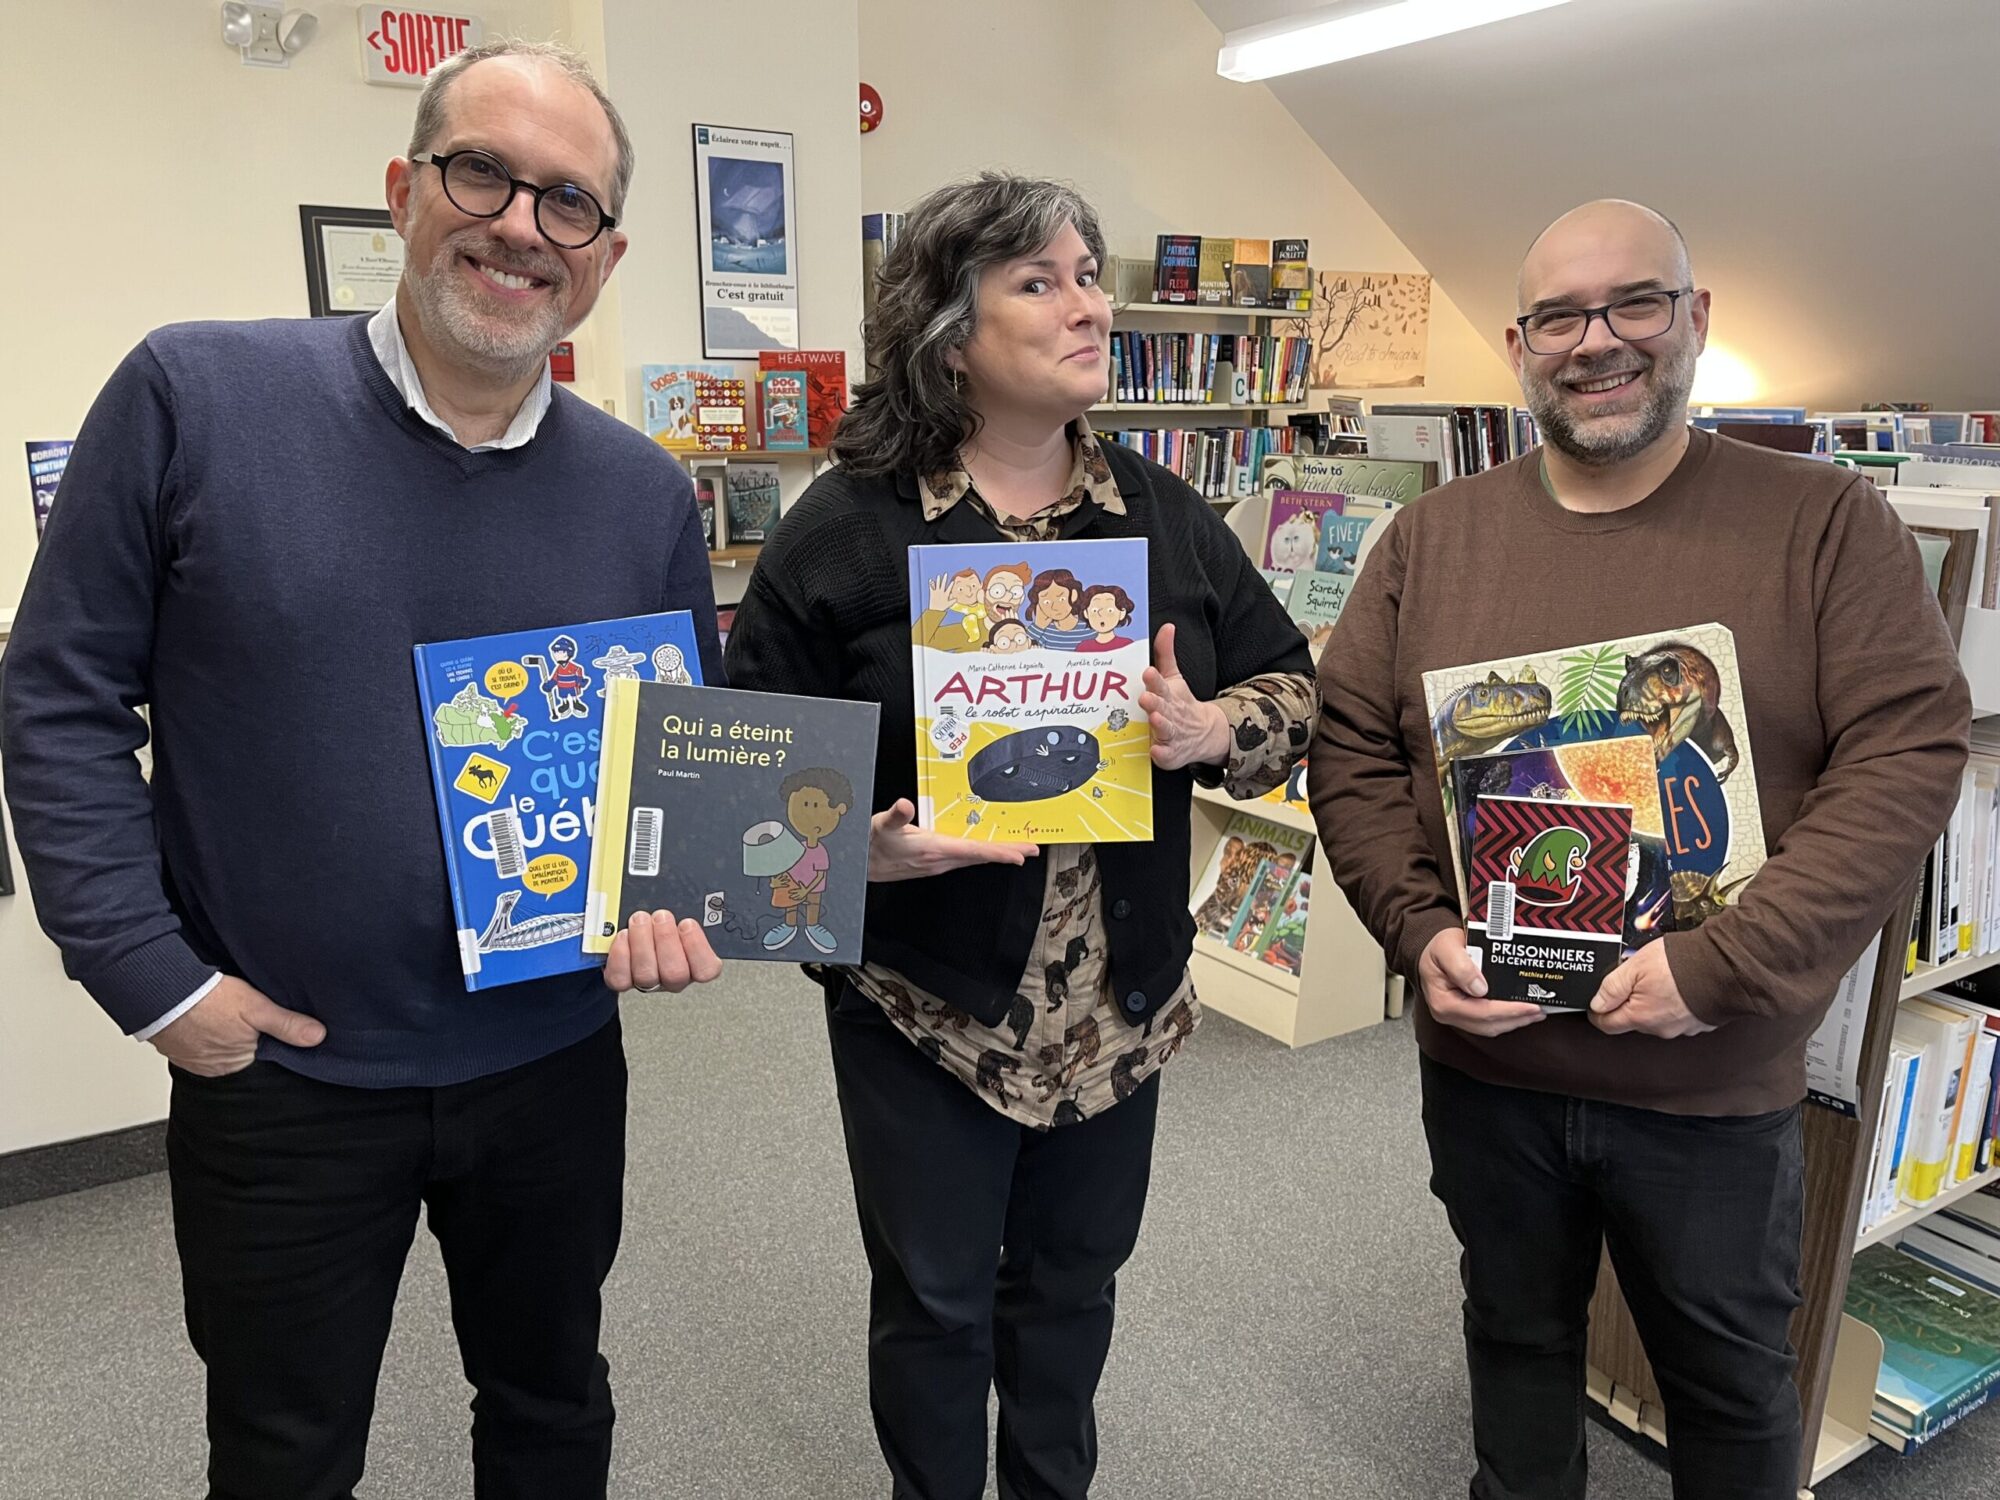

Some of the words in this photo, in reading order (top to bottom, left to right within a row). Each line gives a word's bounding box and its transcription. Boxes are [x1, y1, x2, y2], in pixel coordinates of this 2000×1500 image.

[741, 139, 758, 147] votre
[1167, 245, 1195, 256] PATRICIA
[1279, 250, 1305, 259] FOLLETT
[1286, 244, 1300, 252] KEN
[1163, 256, 1198, 267] CORNWELL
[1169, 279, 1189, 289] FLESH
[1199, 281, 1230, 289] HUNTING
[717, 288, 745, 300] C'est
[748, 291, 785, 302] gratuit
[778, 353, 841, 364] HEATWAVE
[650, 371, 678, 392] DOGS
[772, 379, 796, 387] DOG
[1235, 378, 1245, 397] C
[1303, 464, 1327, 476] How
[1331, 465, 1343, 476] to
[1238, 473, 1247, 491] E
[1337, 465, 1366, 494] the
[1367, 469, 1415, 499] book
[1281, 497, 1301, 505] BETH
[1303, 498, 1332, 507] STERN
[1329, 522, 1354, 545] FIVE
[1309, 580, 1345, 599] Scaredy
[1306, 593, 1342, 611] Squirrel
[1093, 658, 1113, 667] Grand
[933, 670, 1130, 706] ARTHUR
[965, 706, 977, 718] le
[982, 706, 1020, 718] robot
[1024, 703, 1100, 722] aspirateur
[662, 715, 703, 737] Qui
[709, 721, 723, 733] a
[729, 720, 793, 744] éteint
[935, 718, 957, 740] BIBLIO
[522, 728, 600, 762] C'es
[949, 732, 968, 751] PEB
[660, 739, 679, 760] la
[686, 742, 771, 767] lumière
[777, 750, 787, 768] ?
[657, 768, 675, 778] Paul
[675, 769, 701, 780] Martin
[510, 794, 536, 816] le
[1230, 816, 1307, 851] ANIMALS
[1492, 942, 1595, 963] PRISONNIERS
[1491, 955, 1505, 964] DU
[1506, 957, 1545, 968] CENTRE
[1546, 961, 1594, 973] D'ACHATS
[1519, 970, 1544, 979] Mathieu
[1545, 972, 1564, 980] Fortin
[1811, 1094, 1845, 1110] .ca
